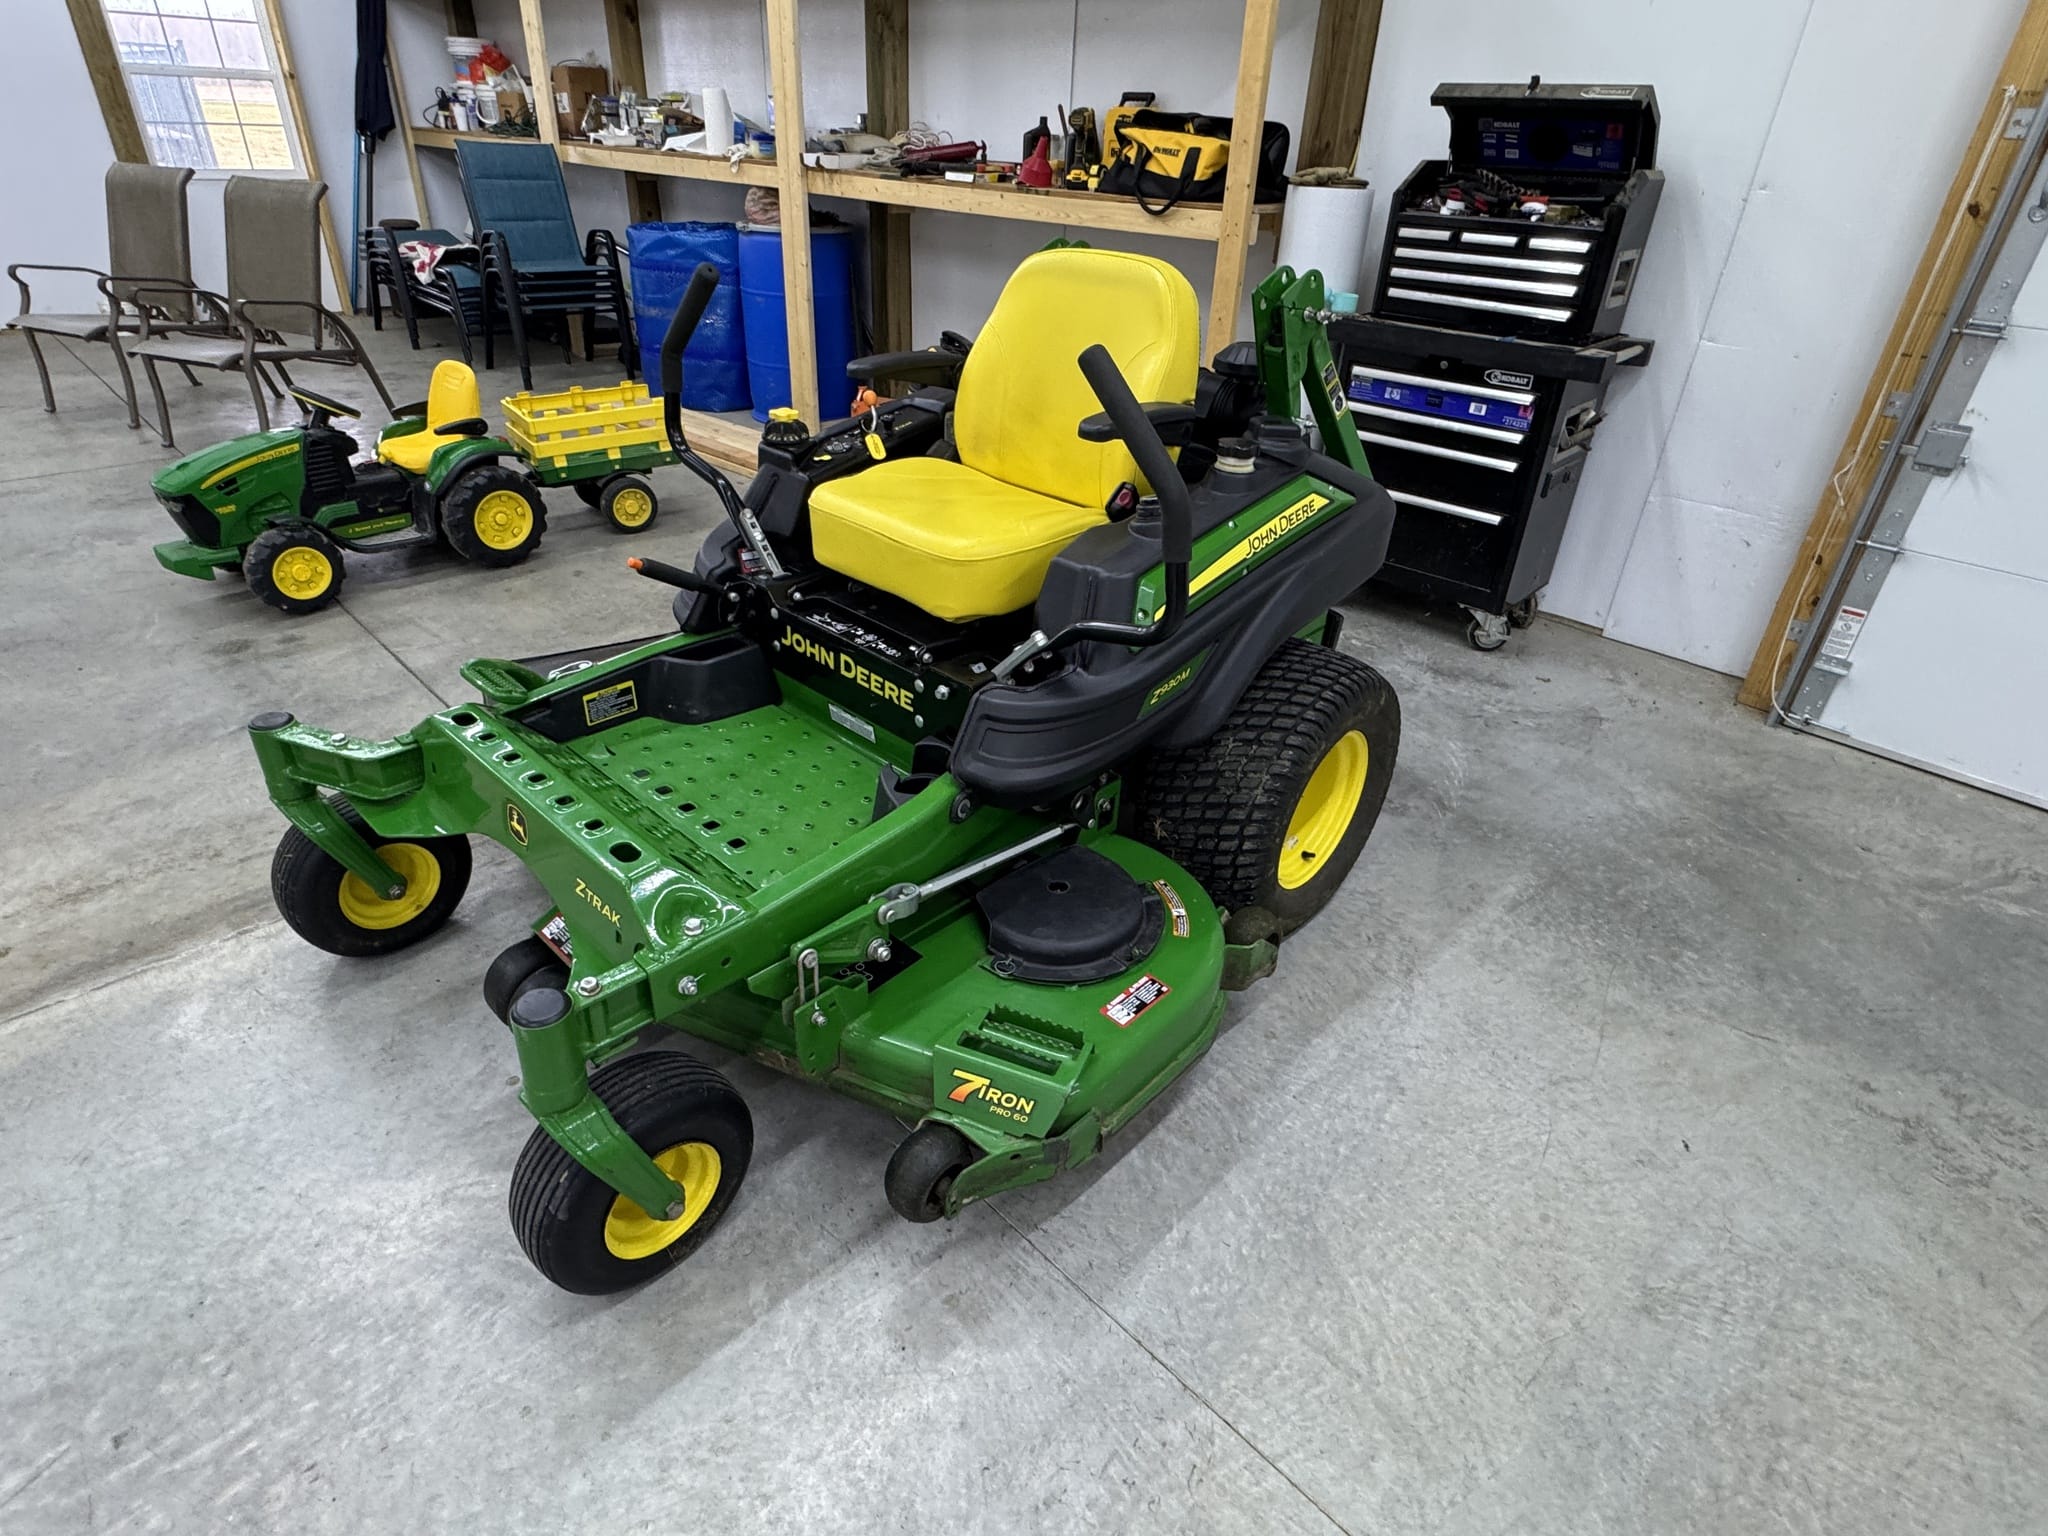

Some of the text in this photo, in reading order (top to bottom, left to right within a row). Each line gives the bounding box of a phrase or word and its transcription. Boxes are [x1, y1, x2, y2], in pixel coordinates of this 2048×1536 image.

[1493, 121, 1521, 129] KOBALT
[1501, 375, 1529, 385] KOBALT
[1246, 499, 1316, 556] JOHN DEERE
[781, 624, 834, 671] JOHN
[840, 652, 914, 713] DEERE
[575, 877, 621, 928] ZTRAK
[989, 1105, 1028, 1123] PRO 60
